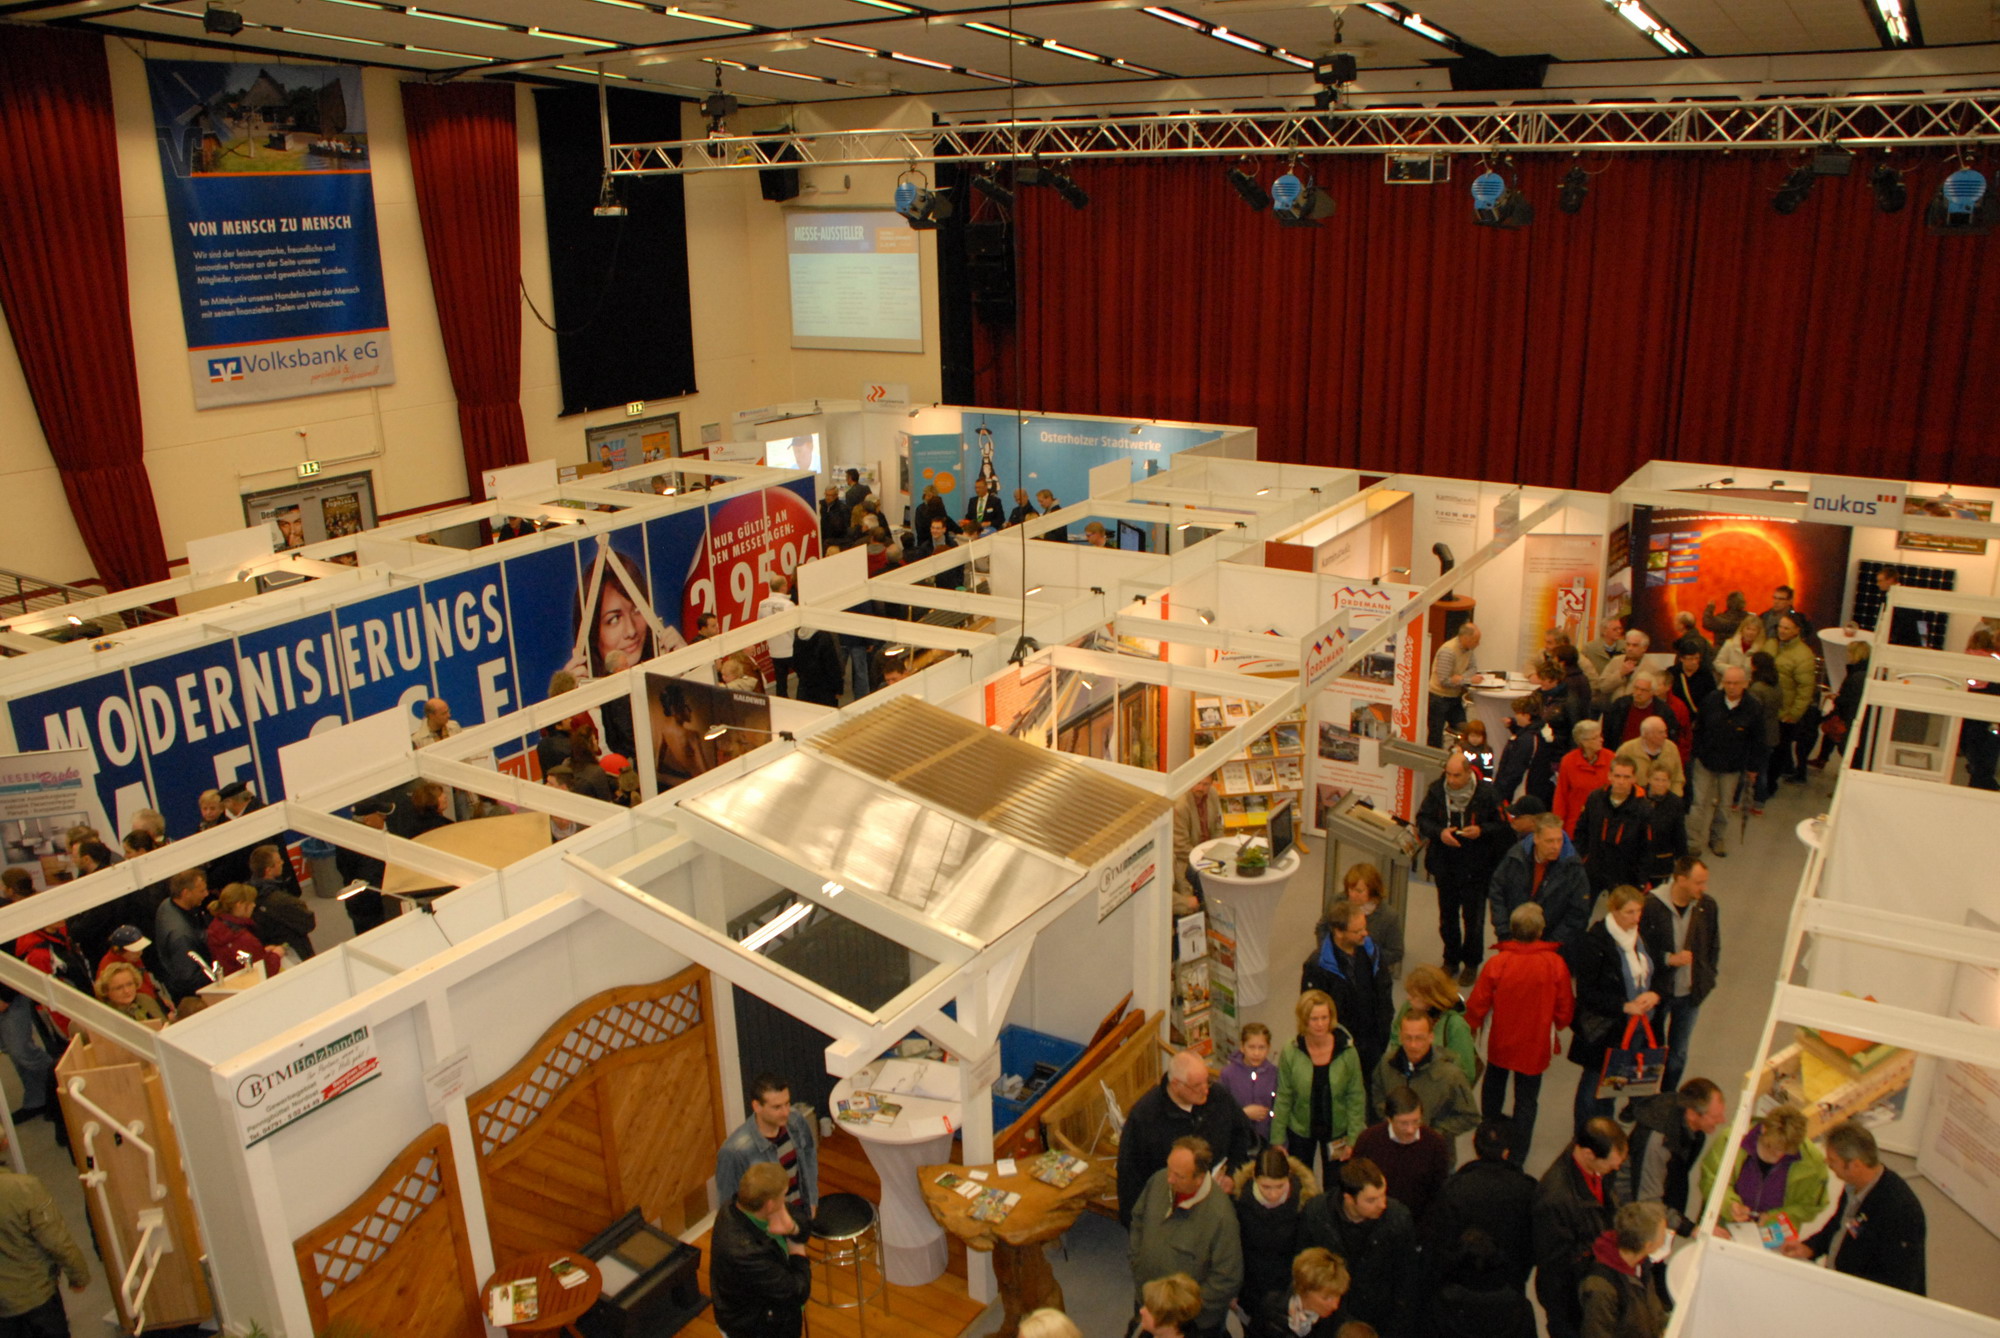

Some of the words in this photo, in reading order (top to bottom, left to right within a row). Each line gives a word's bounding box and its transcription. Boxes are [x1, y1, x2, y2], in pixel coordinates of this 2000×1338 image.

[189, 221, 217, 236] VON
[222, 218, 276, 235] MENSCH
[280, 217, 298, 232] ZU
[302, 215, 352, 231] MENSCH
[794, 226, 865, 241] MESSE-AUSSTELLER
[193, 250, 208, 259] Wir
[209, 249, 222, 258] sind
[223, 249, 235, 257] der
[324, 243, 336, 252] und
[229, 260, 255, 270] Partner
[266, 259, 279, 268] der
[279, 258, 296, 267] Seite
[297, 258, 321, 266] unserer
[234, 273, 263, 284] privaten
[264, 272, 277, 281] und
[278, 269, 321, 281] gewerblichen
[200, 298, 210, 306] Im
[210, 295, 247, 306] Mittelpunkt
[248, 293, 274, 302] unseres
[274, 290, 306, 301] Handelns
[306, 288, 322, 297] steht
[322, 288, 333, 296] der
[334, 285, 360, 295] Mensch
[201, 310, 213, 318] mit
[214, 309, 236, 317] seinen
[236, 305, 274, 316] finanziellen
[275, 303, 296, 312] Zielen
[297, 301, 309, 310] und
[243, 344, 348, 373] Volksbank
[353, 341, 379, 360] eG
[1040, 431, 1098, 446] Osterholzer
[1101, 436, 1161, 452] Stadtwerke
[713, 531, 734, 549] NUR
[737, 514, 772, 538] GÜLTIG
[775, 509, 788, 524] AN
[711, 545, 729, 567] DEN
[732, 524, 795, 557] MESSETAGEN:
[1341, 598, 1392, 611] ORDEMANN
[1310, 645, 1345, 677] ORDEMANN
[44, 584, 503, 775] MODERNISIERUNGS
[1391, 636, 1415, 729] Extraklasse
[733, 693, 766, 706] KALDEWEI
[249, 1063, 293, 1098] BTM
[293, 1026, 369, 1075] Holzhandel
[265, 1081, 317, 1113] Gewerbegebiet
[291, 1089, 319, 1108] Nordost
